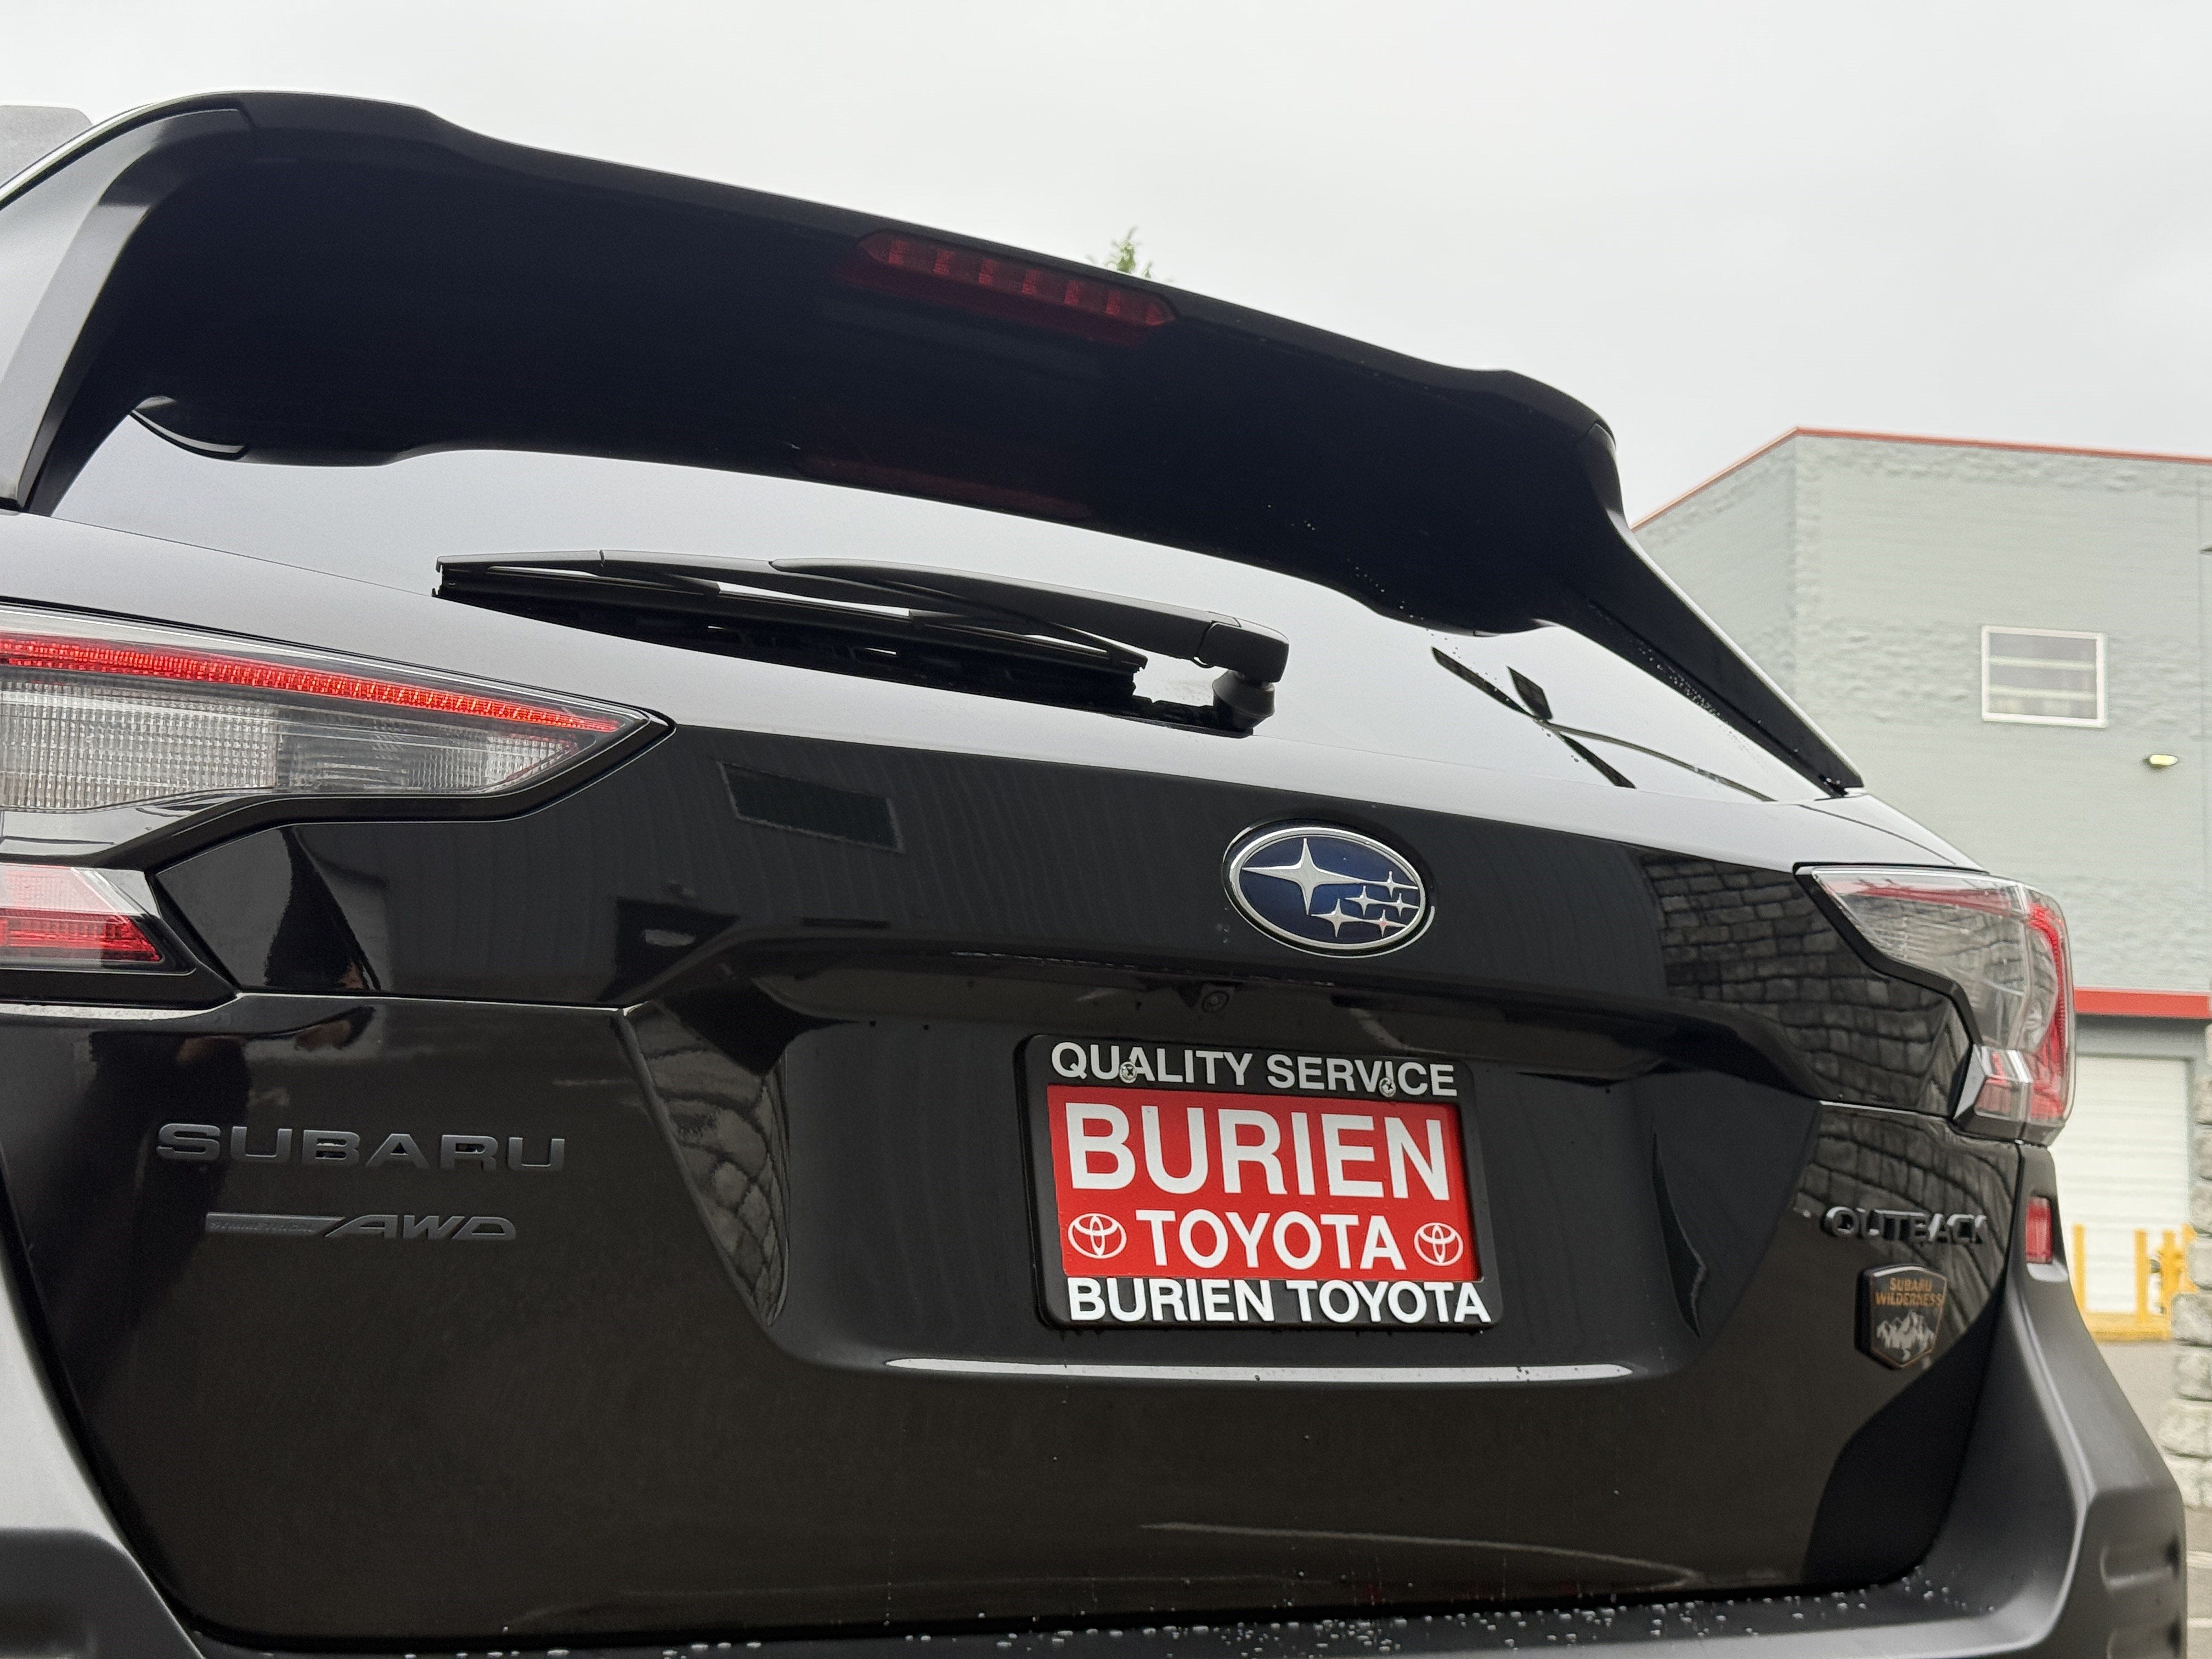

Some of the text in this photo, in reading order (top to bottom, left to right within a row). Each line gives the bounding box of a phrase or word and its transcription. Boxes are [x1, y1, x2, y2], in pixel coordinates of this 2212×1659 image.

[1051, 1042, 1458, 1097] QUALITY SERVICE
[156, 1122, 566, 1172] SUBARU
[1065, 1102, 1450, 1201] BURIEN
[325, 1214, 517, 1240] AWD
[1136, 1209, 1407, 1271] TOYOTA
[1067, 1277, 1492, 1324] BURIEN TOYOTA
[1875, 1291, 1944, 1307] WILDERNESS
[1889, 1277, 1932, 1292] SUBARU
